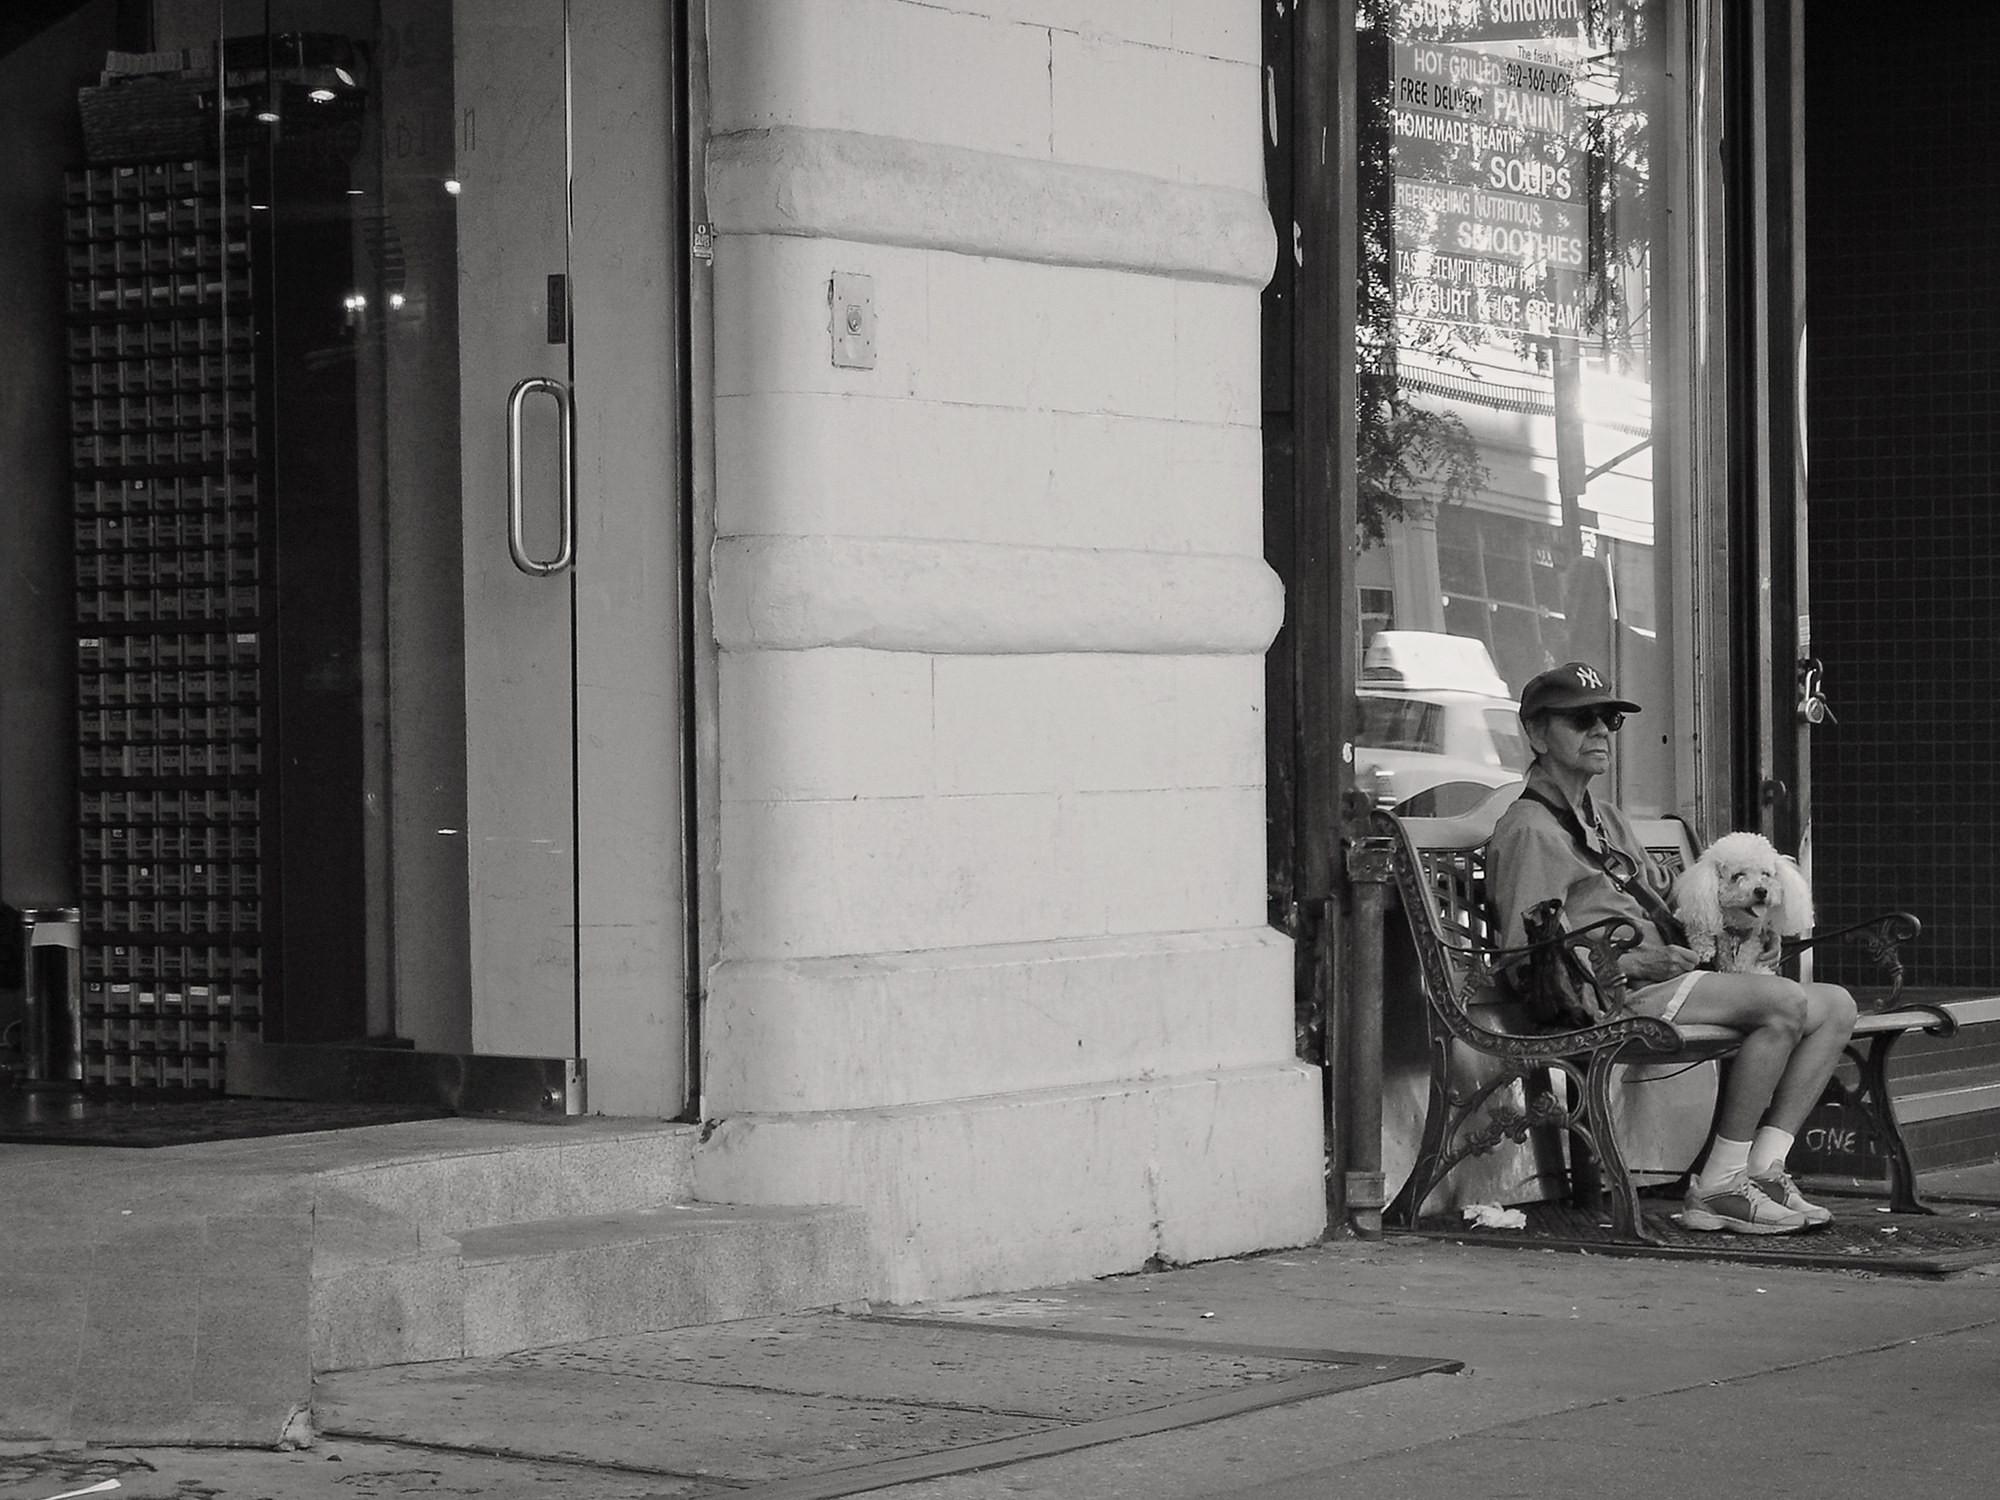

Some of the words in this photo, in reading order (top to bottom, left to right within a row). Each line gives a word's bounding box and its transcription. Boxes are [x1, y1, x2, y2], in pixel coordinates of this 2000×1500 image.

[1414, 48, 1443, 75] HOT
[1449, 55, 1500, 86] GRILLED
[1400, 76, 1428, 106] FREE
[1493, 87, 1565, 134] PANINI
[1394, 111, 1469, 147] HOMEMADE
[1489, 156, 1572, 200] SOUPS
[1396, 182, 1471, 216] REFRESHING
[1474, 194, 1542, 226] NUTRITIOUS
[1457, 221, 1583, 266] SMOOTHIES
[1806, 1127, 1856, 1155] ONE
